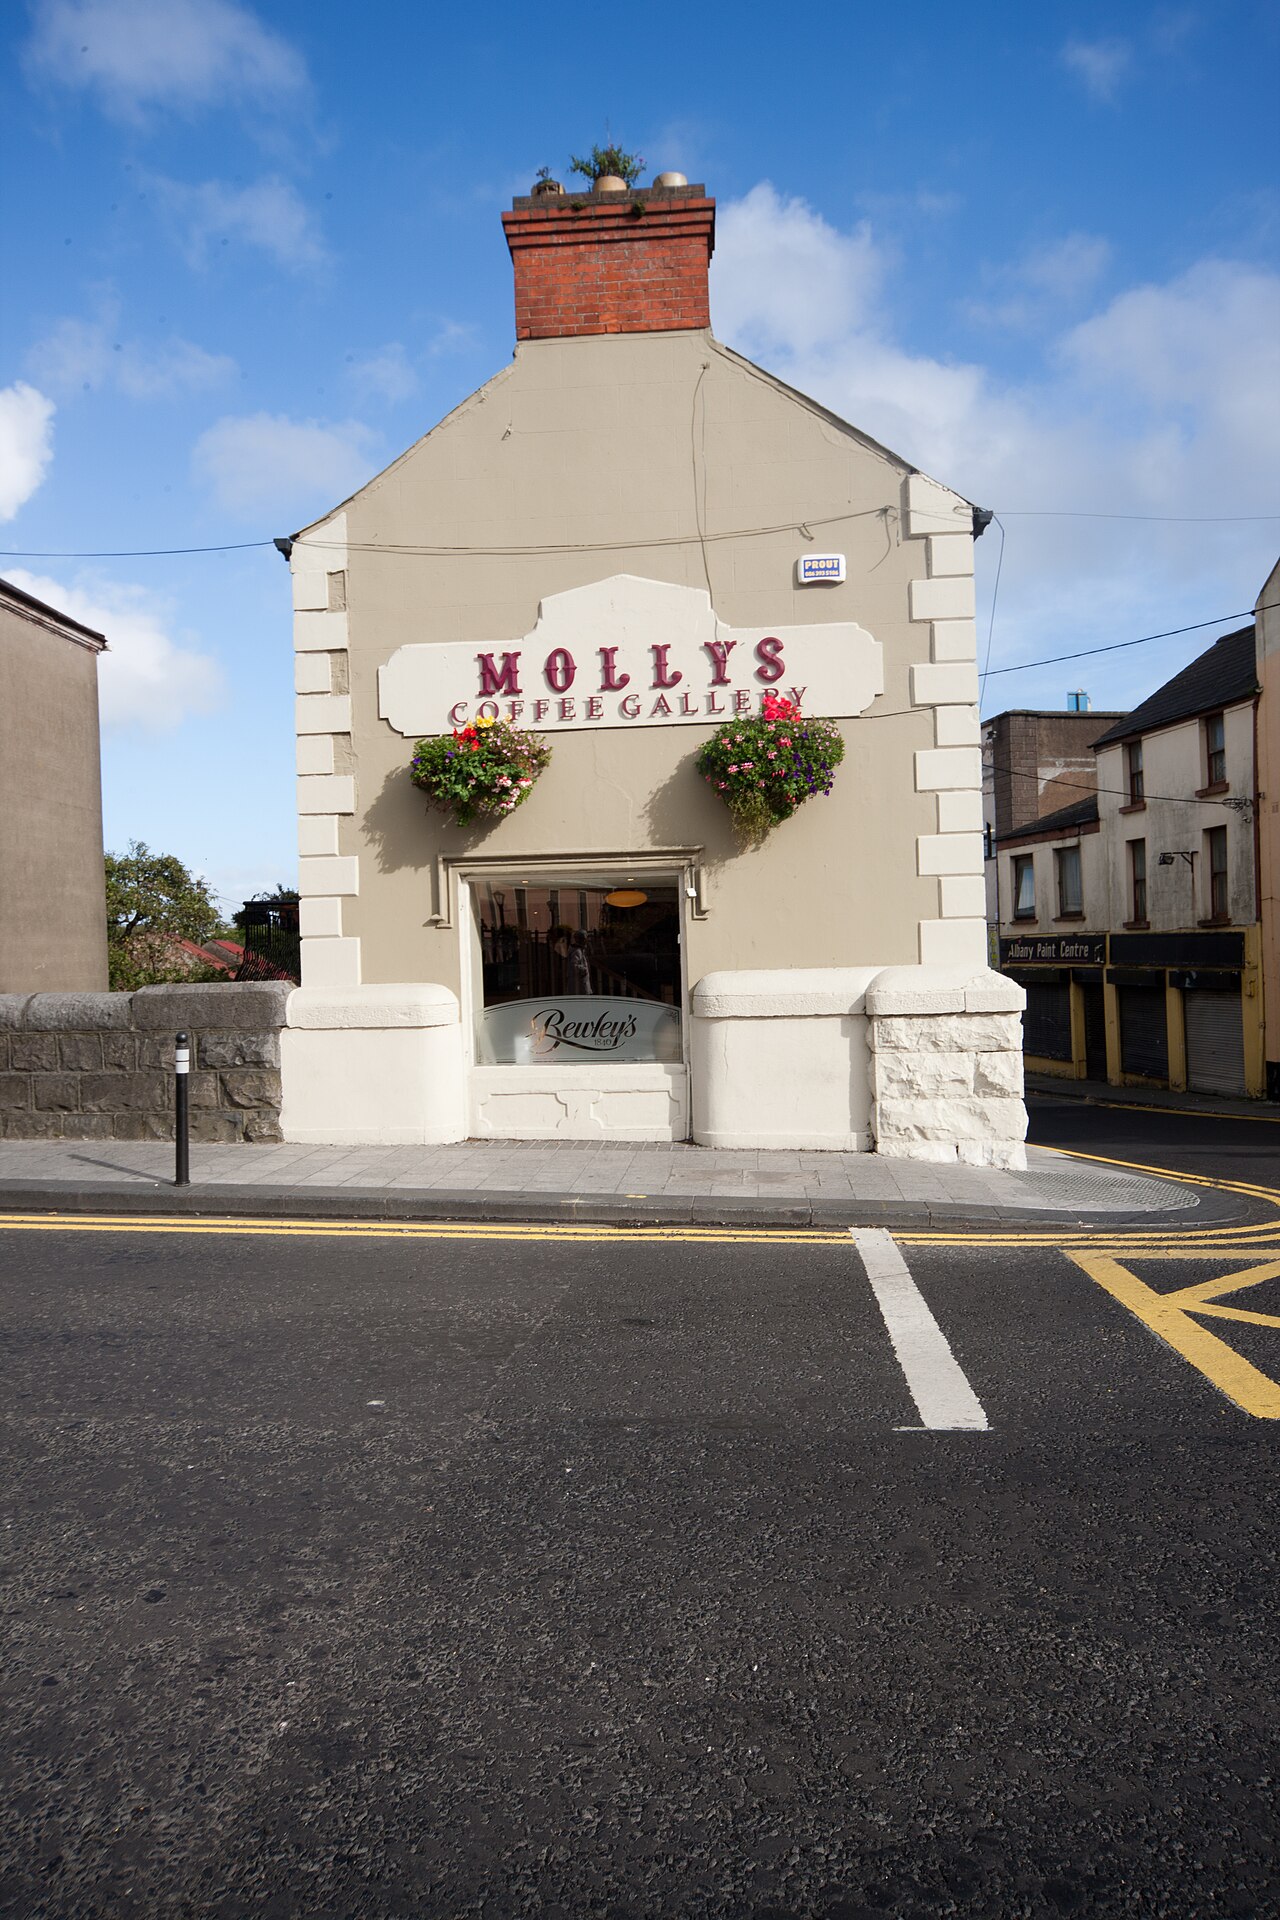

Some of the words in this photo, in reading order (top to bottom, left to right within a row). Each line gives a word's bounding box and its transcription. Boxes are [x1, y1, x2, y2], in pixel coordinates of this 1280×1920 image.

[805, 559, 839, 569] PROUT
[476, 637, 786, 697] MOLLYS
[450, 695, 605, 725] COFFEE
[1008, 943, 1034, 961] Albany
[1037, 942, 1057, 958] Paint
[1060, 940, 1089, 958] Centre
[525, 1008, 638, 1055] Bewley's
[594, 1038, 612, 1046] 1840
